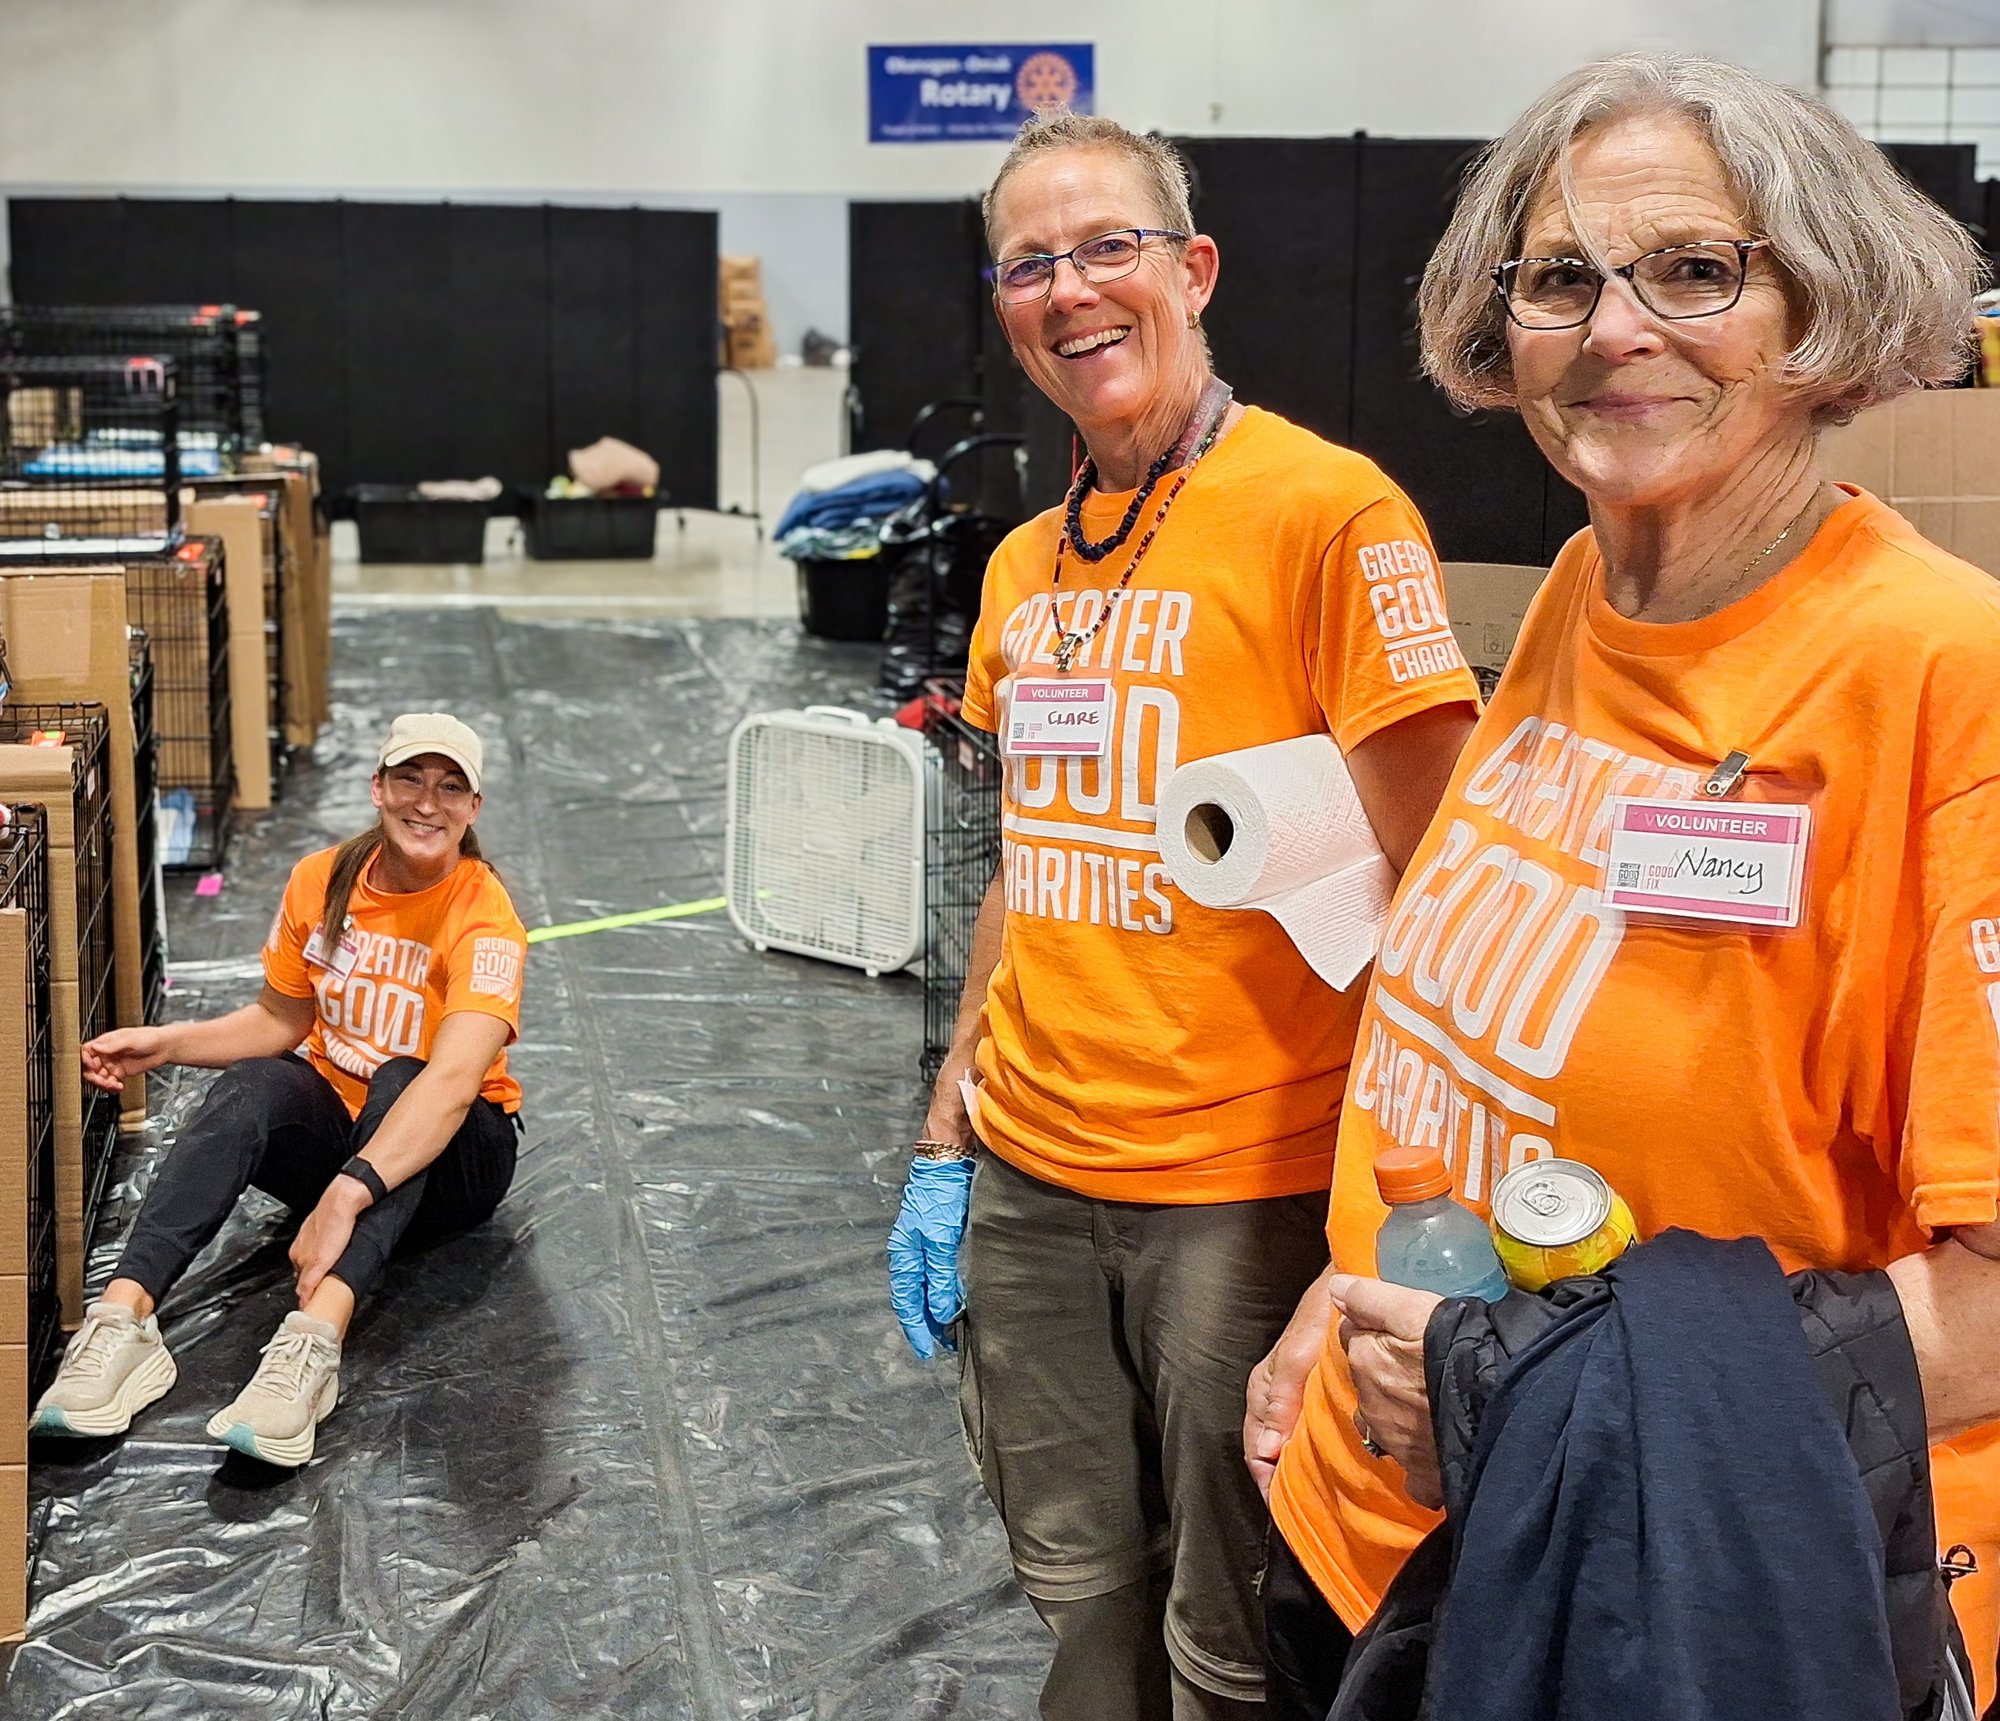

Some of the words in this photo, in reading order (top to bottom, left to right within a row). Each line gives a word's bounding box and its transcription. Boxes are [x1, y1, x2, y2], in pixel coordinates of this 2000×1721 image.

[921, 79, 1012, 112] Rotary
[1387, 639, 1460, 683] CHARI
[1031, 688, 1089, 699] VOLUNTEER
[1048, 710, 1100, 726] CLARE
[1655, 813, 1768, 836] VOLUNTEER
[1646, 878, 1660, 890] FIX
[1674, 846, 1764, 895] Nancy
[1380, 817, 1628, 1079] GOOD
[473, 951, 518, 982] GOOD
[317, 970, 425, 1054] GOOD
